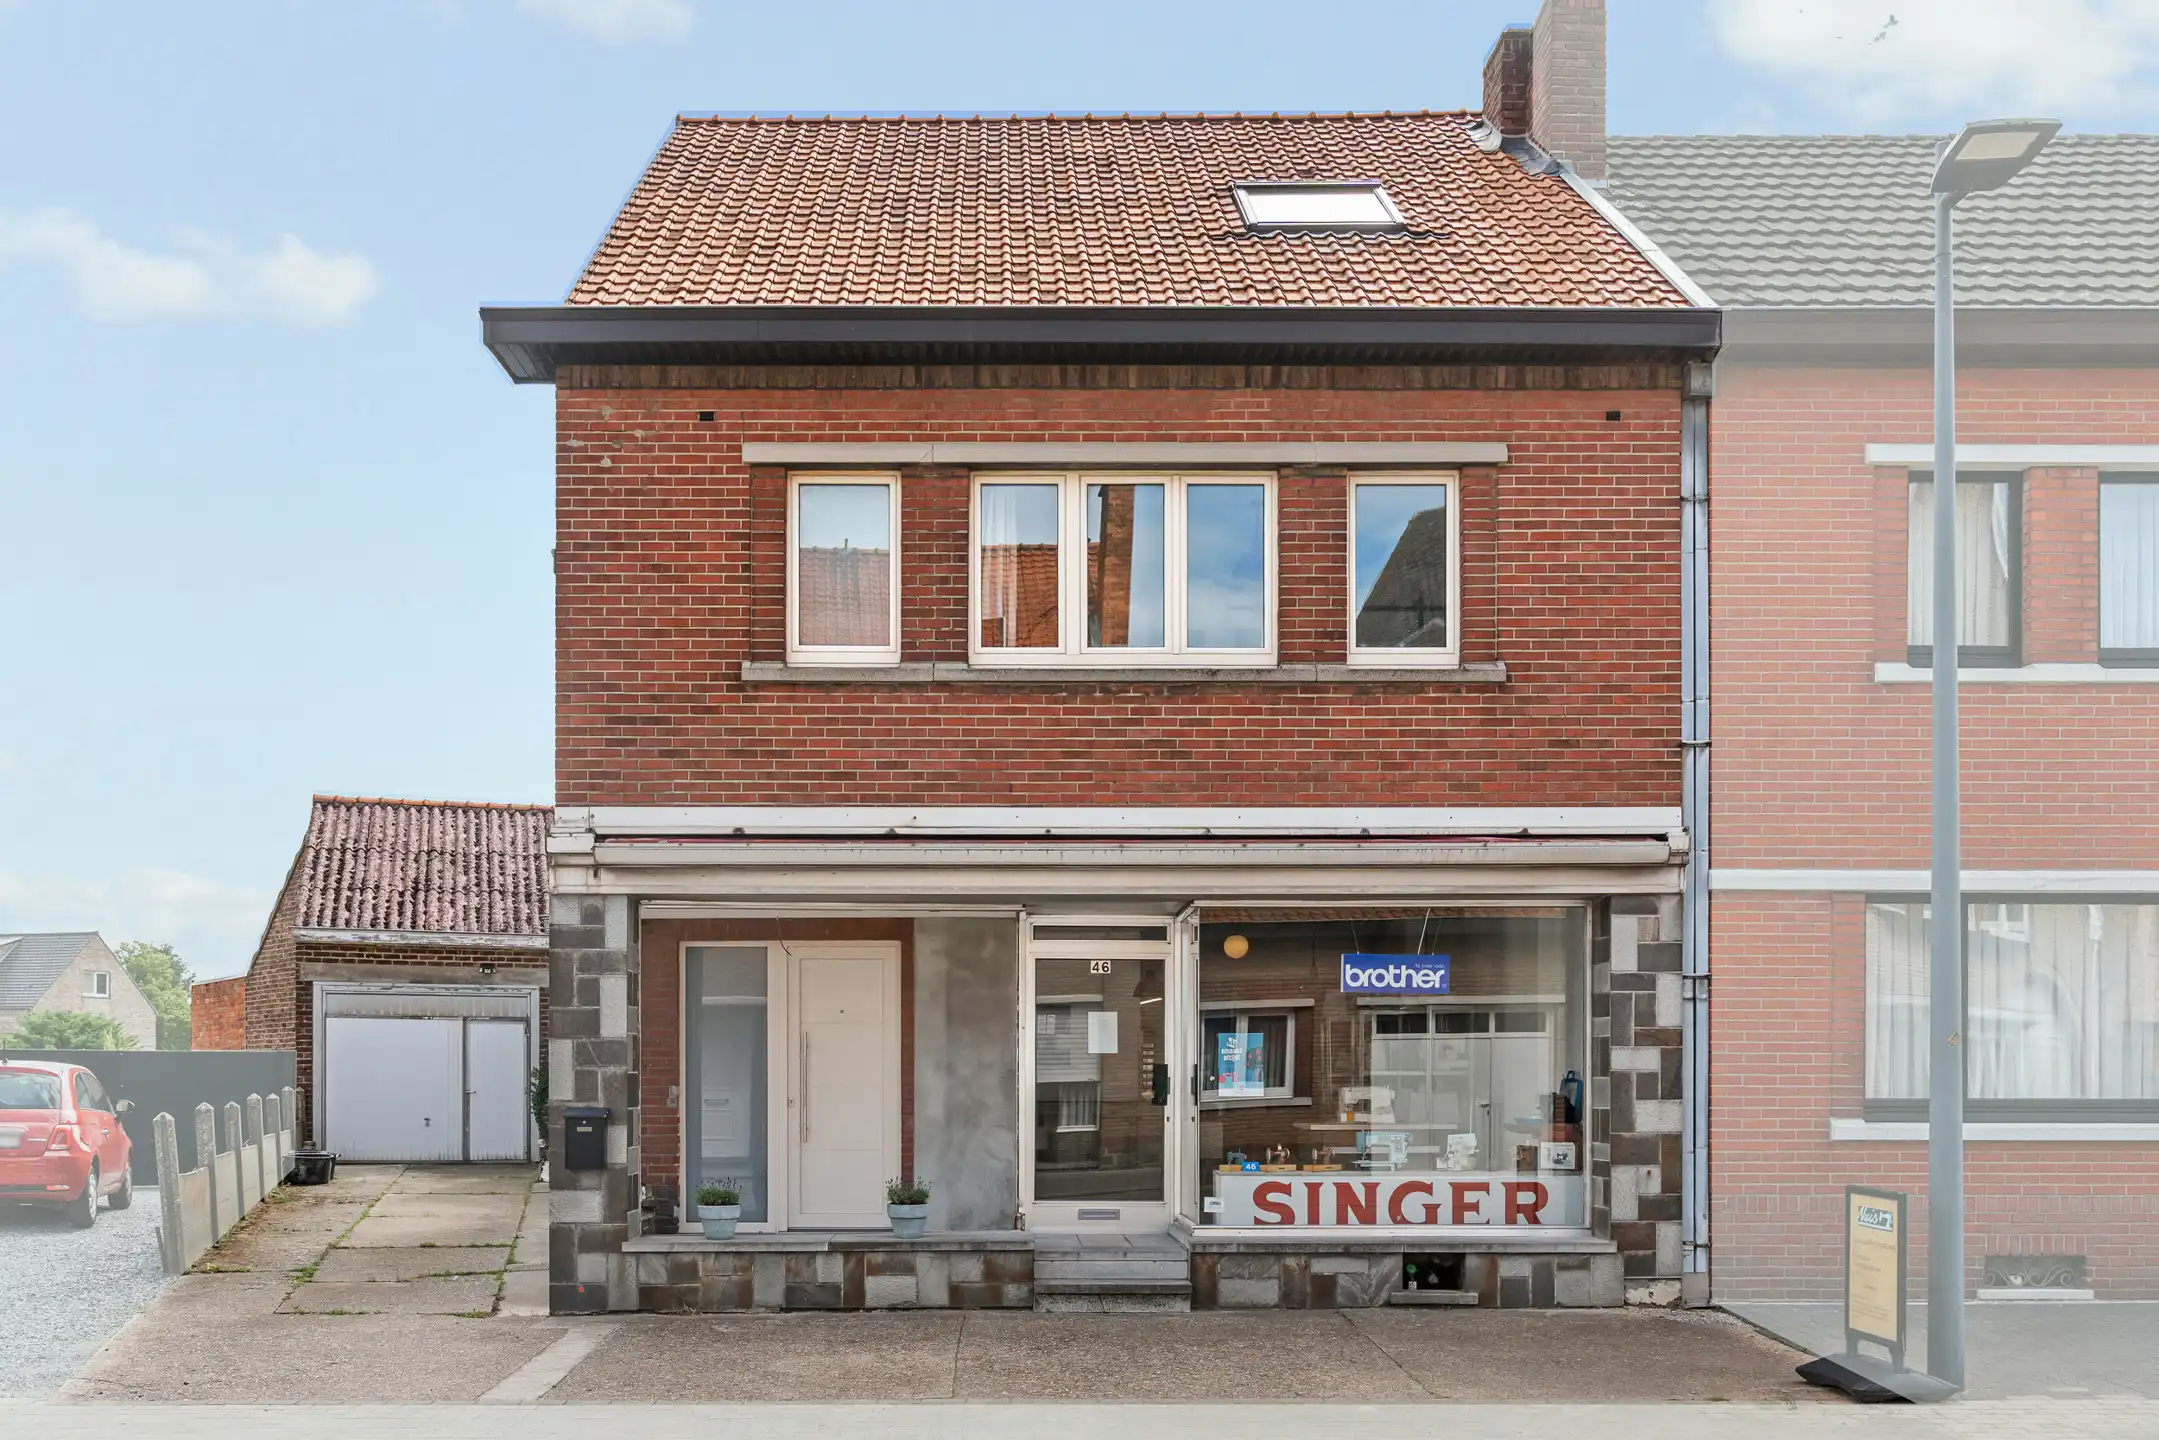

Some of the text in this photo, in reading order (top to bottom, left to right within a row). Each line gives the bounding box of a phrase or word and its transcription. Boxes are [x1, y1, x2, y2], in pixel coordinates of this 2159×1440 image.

[1092, 961, 1110, 972] 46
[1345, 964, 1445, 988] brother
[1245, 1163, 1257, 1171] 46
[1252, 1180, 1549, 1225] SINGER
